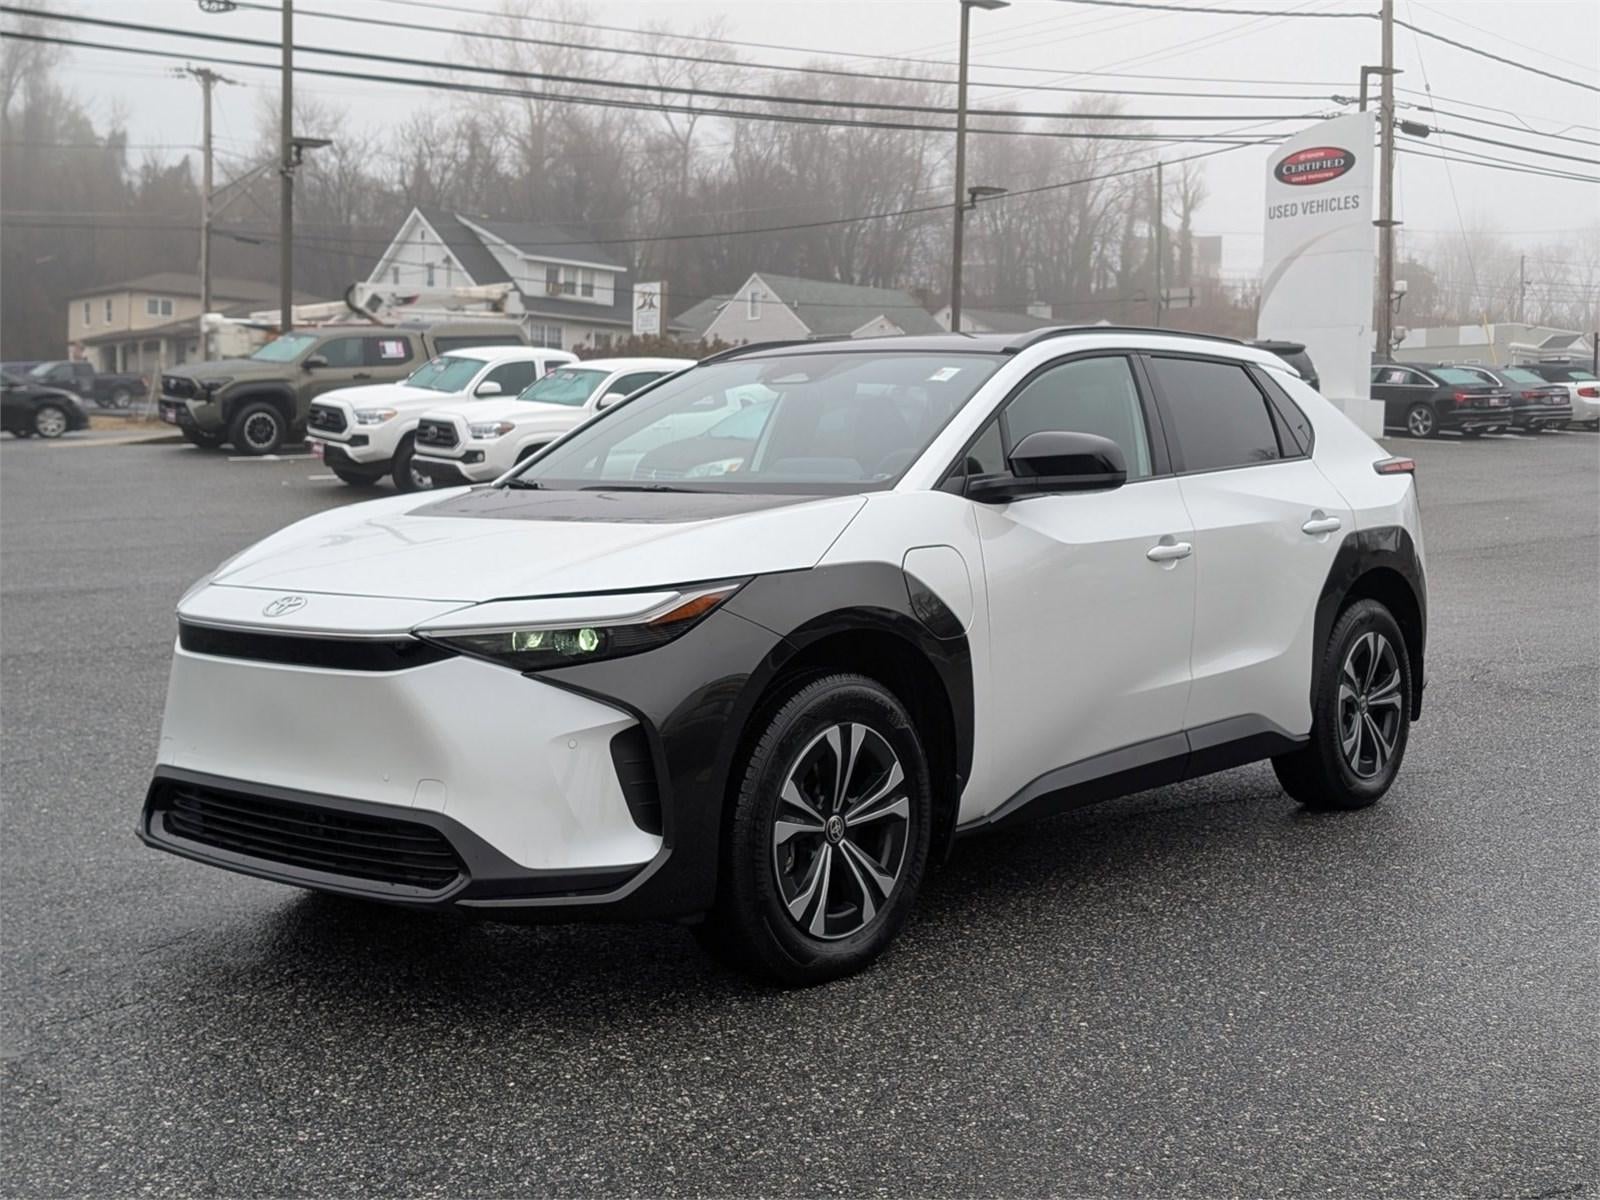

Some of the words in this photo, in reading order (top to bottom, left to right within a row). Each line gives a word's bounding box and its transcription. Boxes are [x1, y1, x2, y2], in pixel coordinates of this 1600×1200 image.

[1282, 158, 1345, 175] CERTIFIED
[1268, 202, 1298, 220] USED
[1301, 194, 1360, 215] VEHICLES
